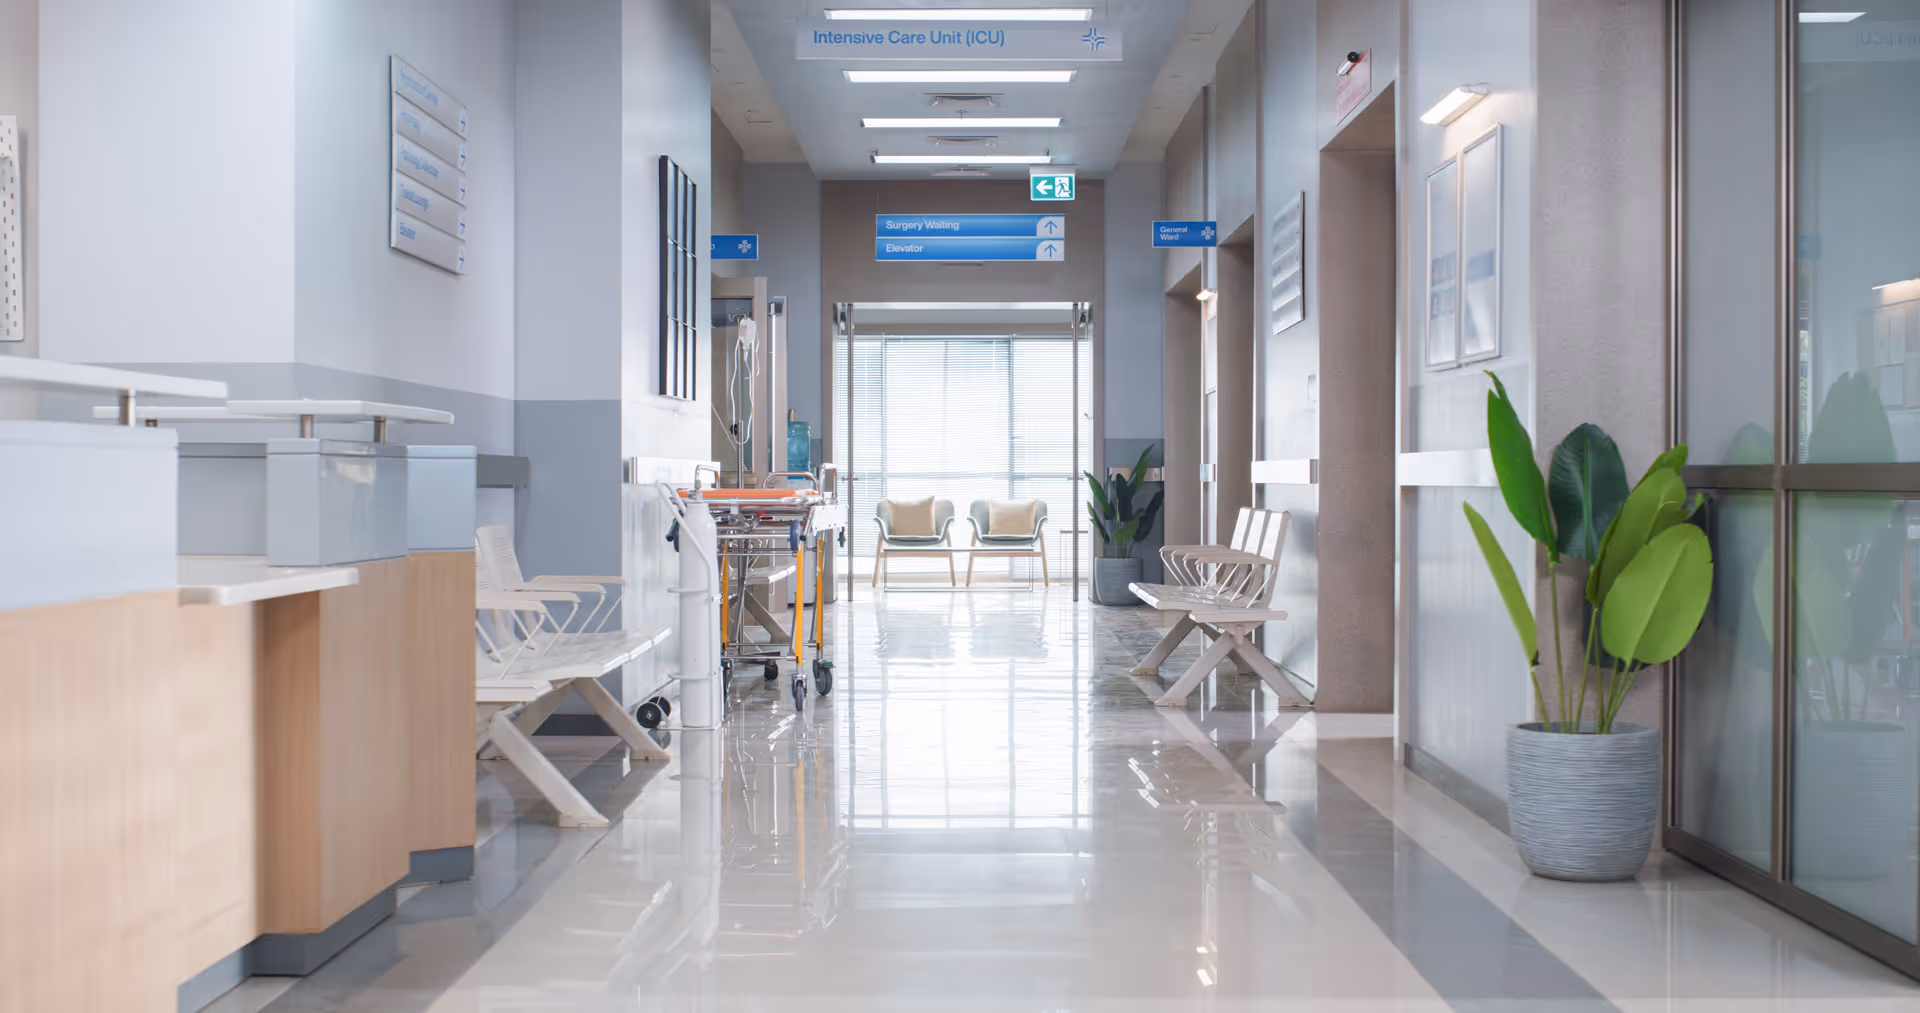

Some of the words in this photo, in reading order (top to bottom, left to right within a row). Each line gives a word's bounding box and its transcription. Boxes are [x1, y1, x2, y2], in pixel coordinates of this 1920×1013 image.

[813, 30, 884, 44] Intensive
[888, 30, 926, 44] Care
[930, 30, 962, 44] Unit
[966, 29, 1005, 47] (ICU)
[886, 220, 923, 231] Surgery
[924, 220, 959, 231] Waiting
[886, 243, 923, 253] Elevator
